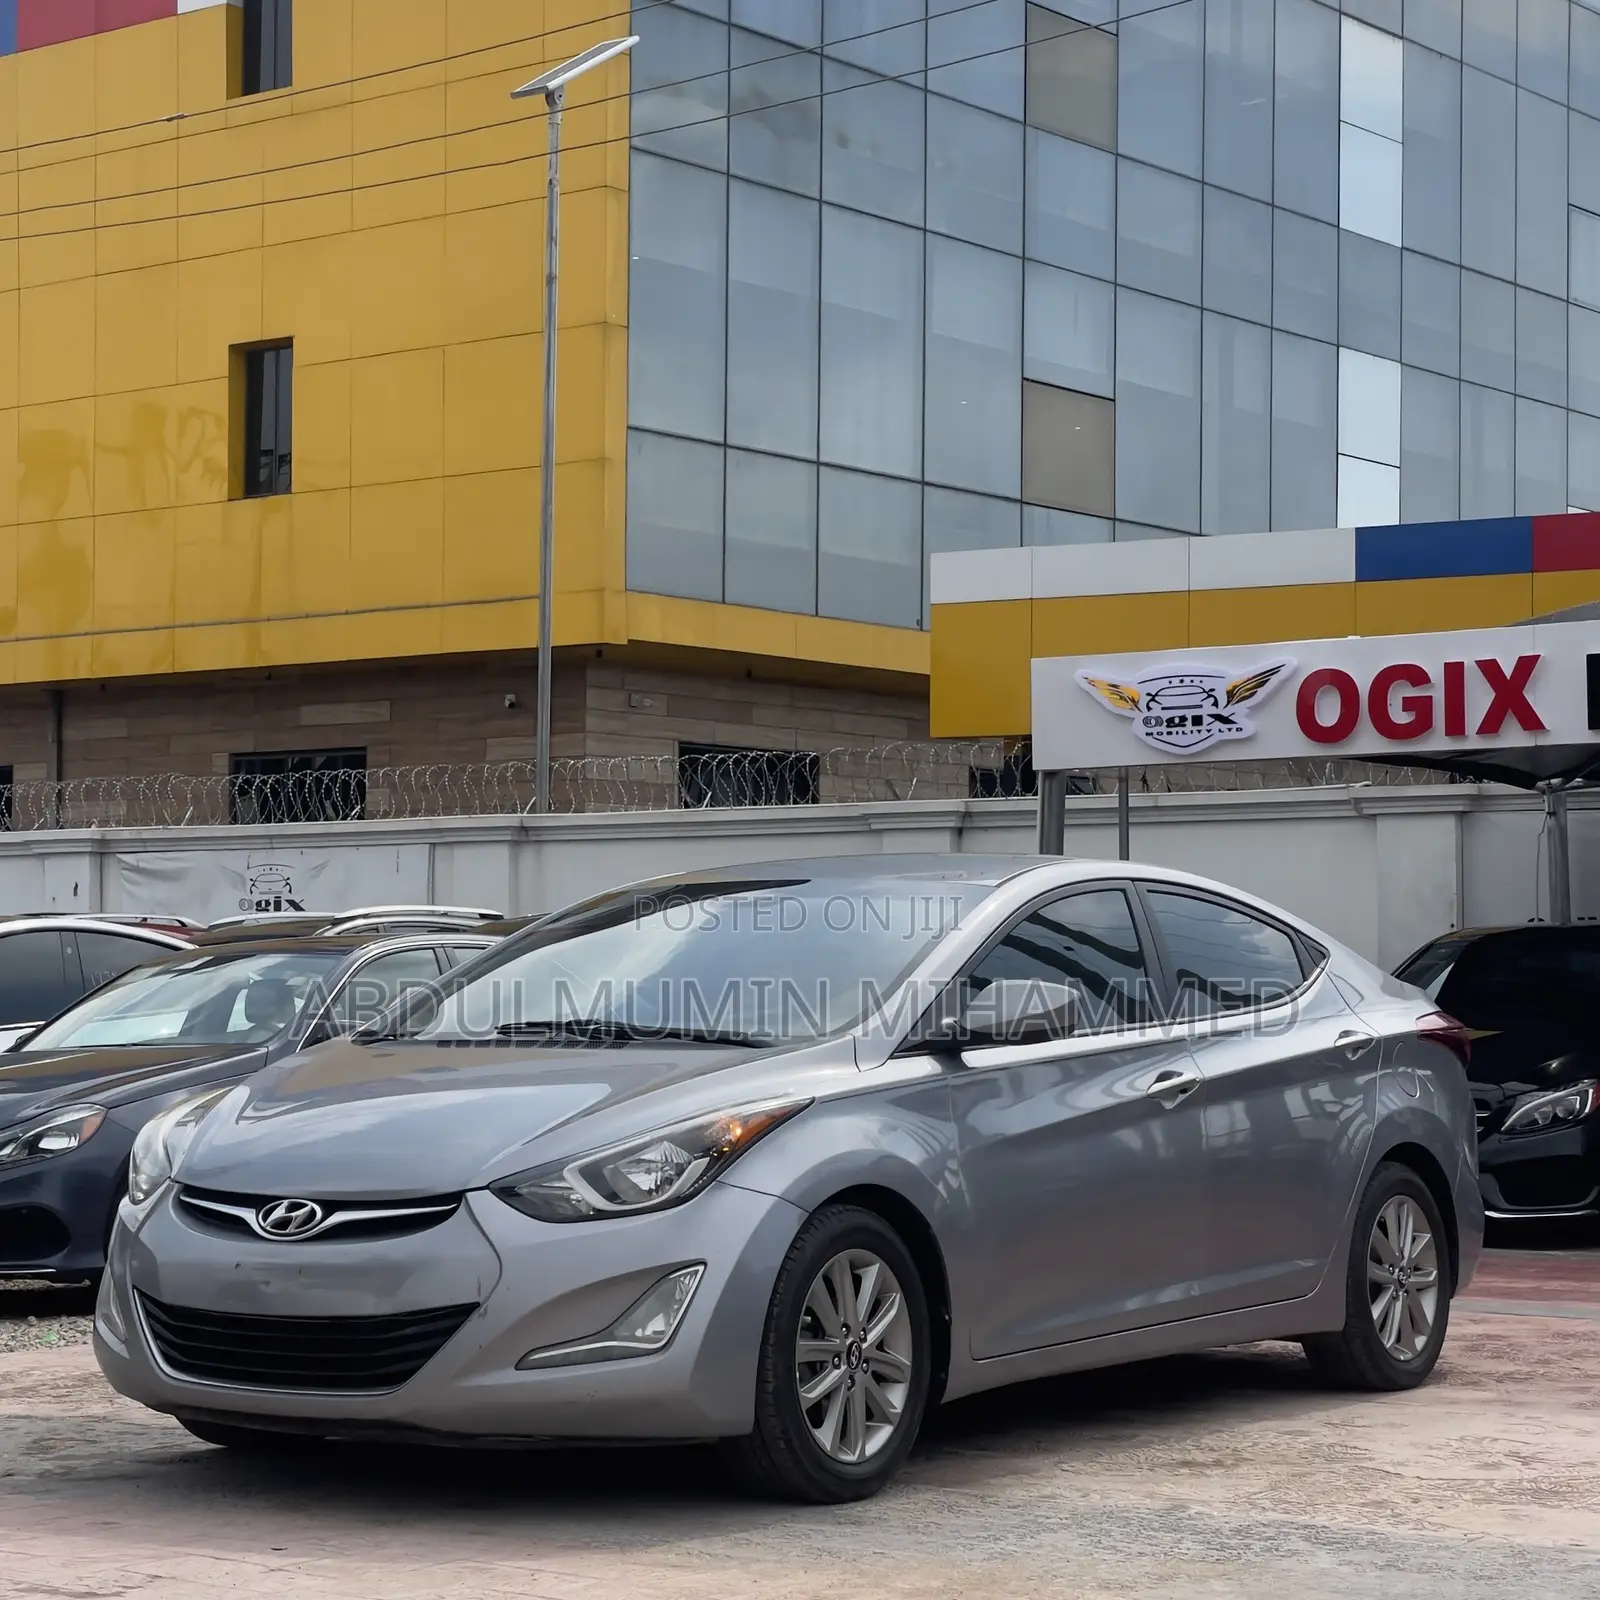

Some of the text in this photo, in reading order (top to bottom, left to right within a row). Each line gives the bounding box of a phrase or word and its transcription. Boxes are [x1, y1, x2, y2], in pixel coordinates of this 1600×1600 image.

[1296, 654, 1546, 744] OGIX
[1145, 726, 1243, 737] MOBILITY LTD
